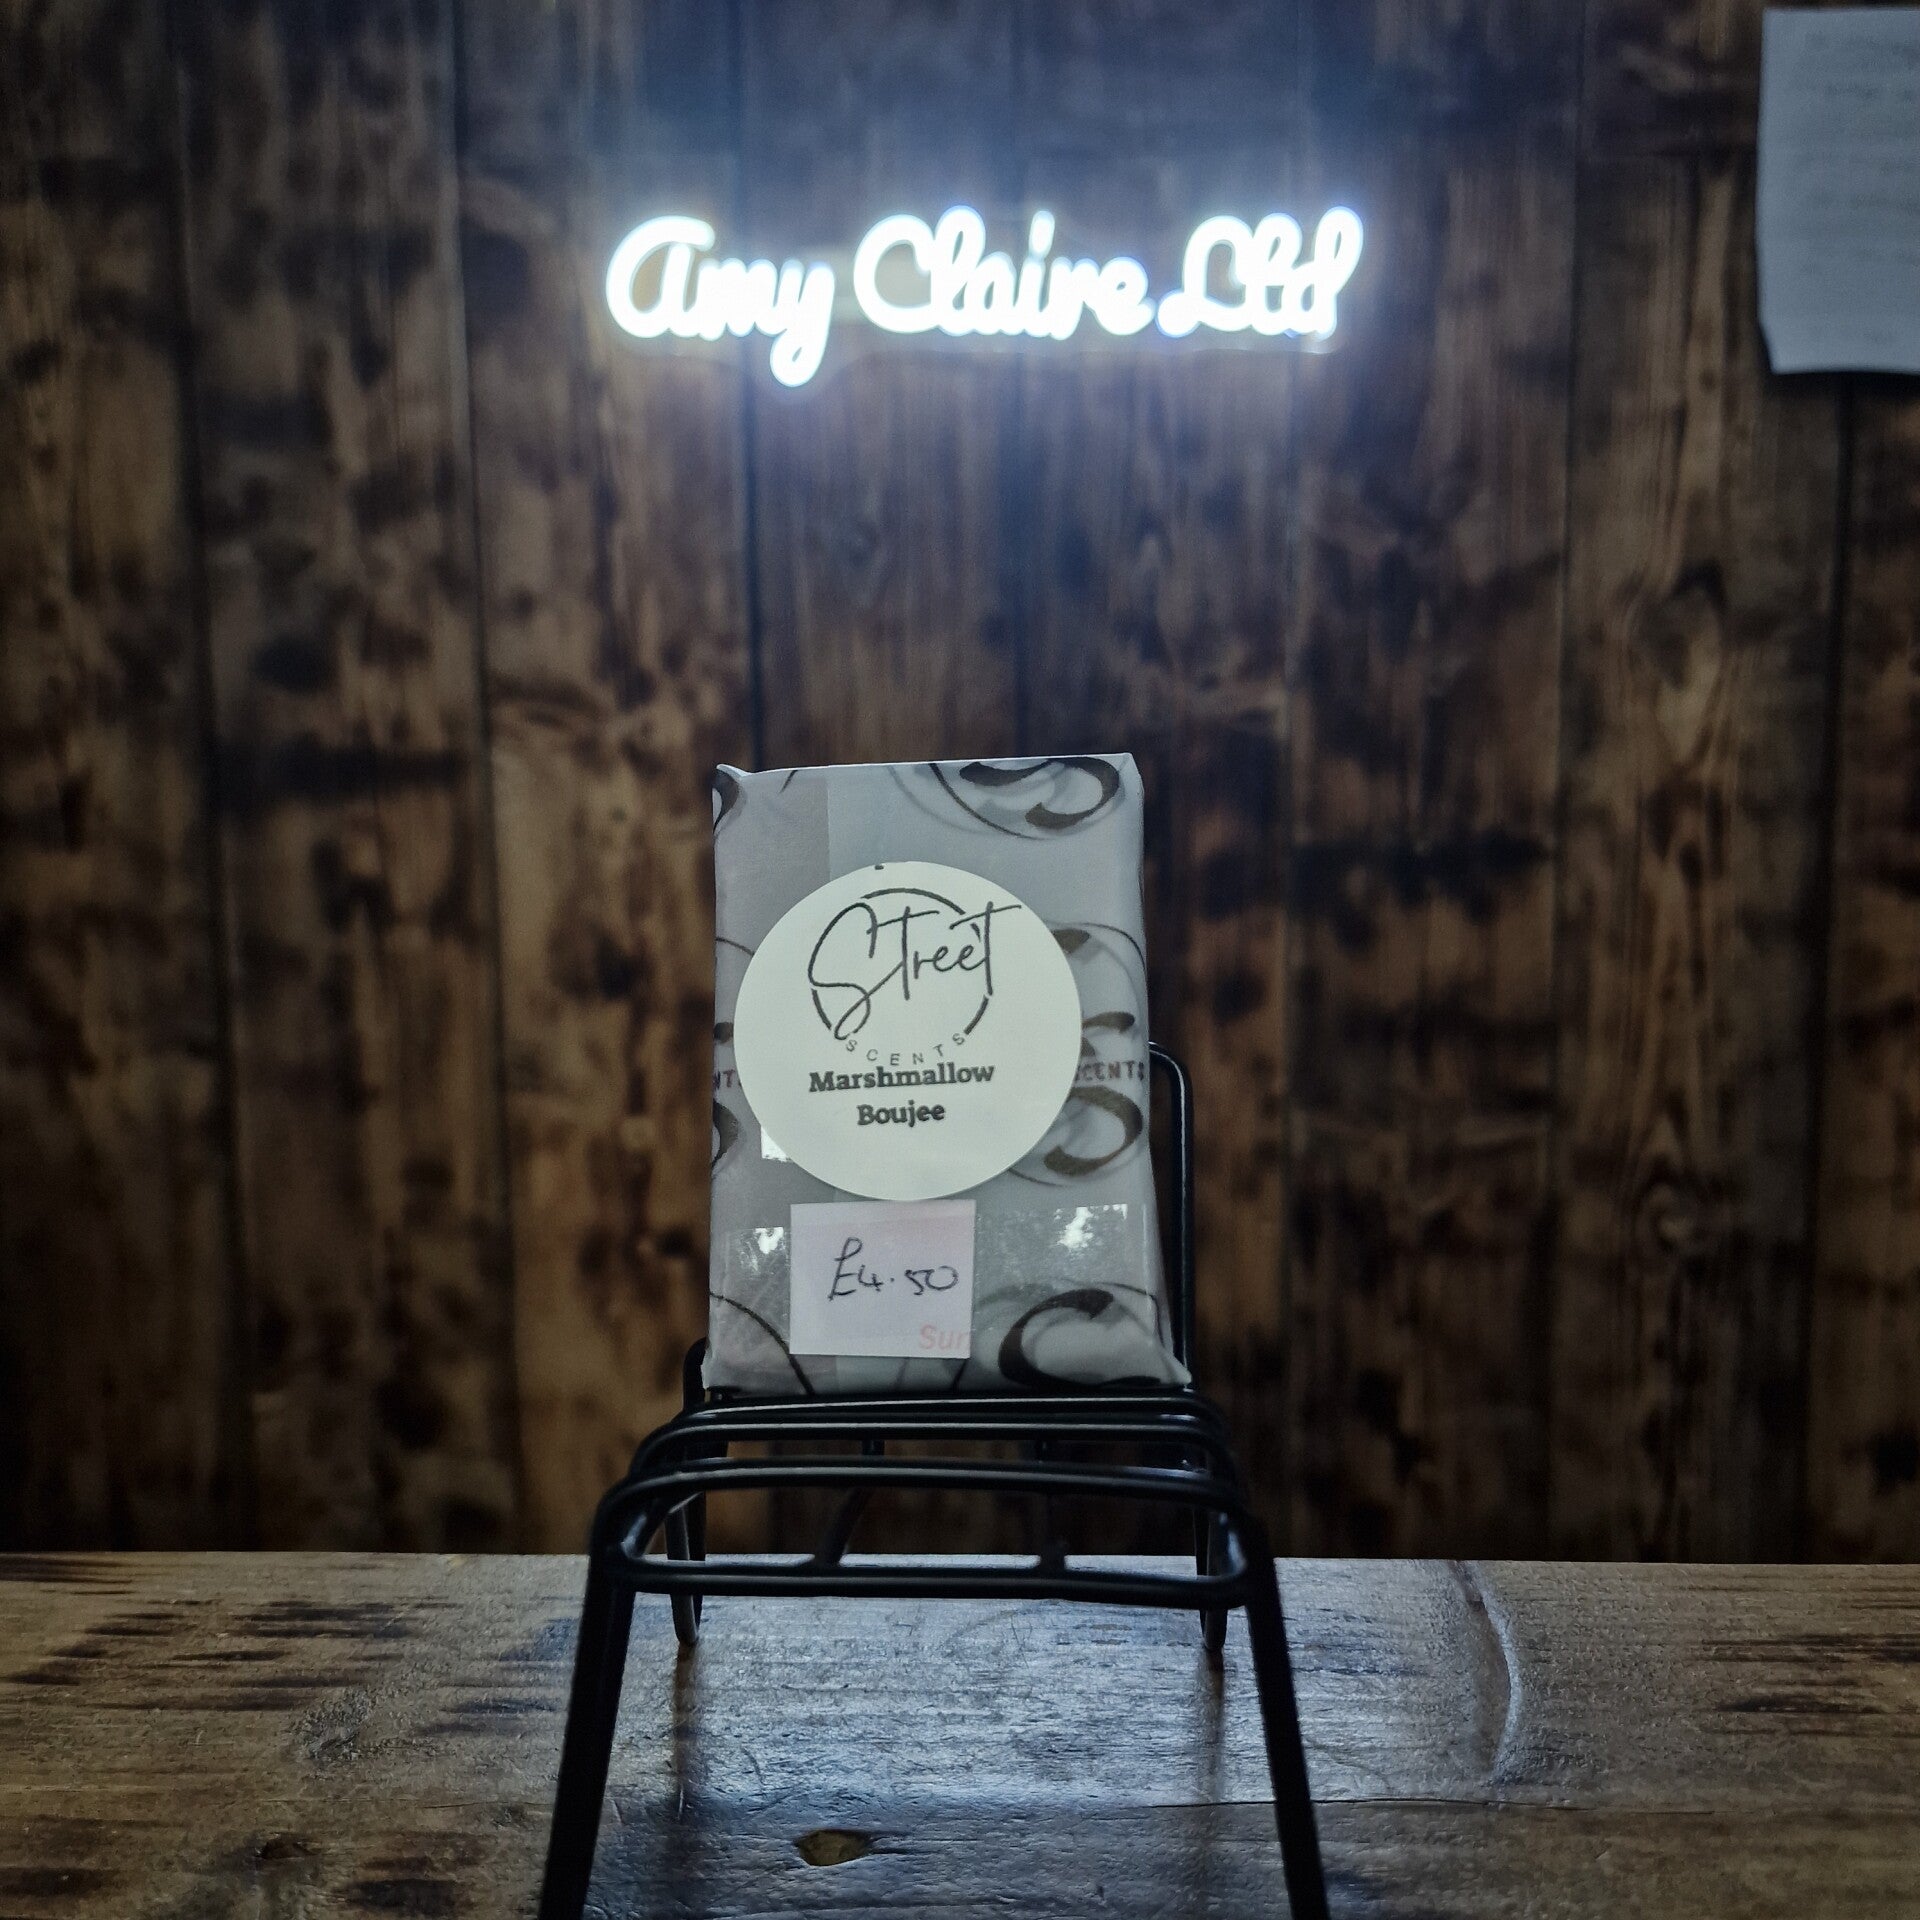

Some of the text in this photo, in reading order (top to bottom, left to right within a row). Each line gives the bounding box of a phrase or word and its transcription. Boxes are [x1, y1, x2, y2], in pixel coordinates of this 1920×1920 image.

[606, 205, 1364, 388] Amy Claire Ltd
[845, 1033, 965, 1067] SCENTS
[808, 1061, 996, 1093] Marshmallow
[856, 1099, 946, 1128] Boujee
[827, 1237, 960, 1301] £4.50
